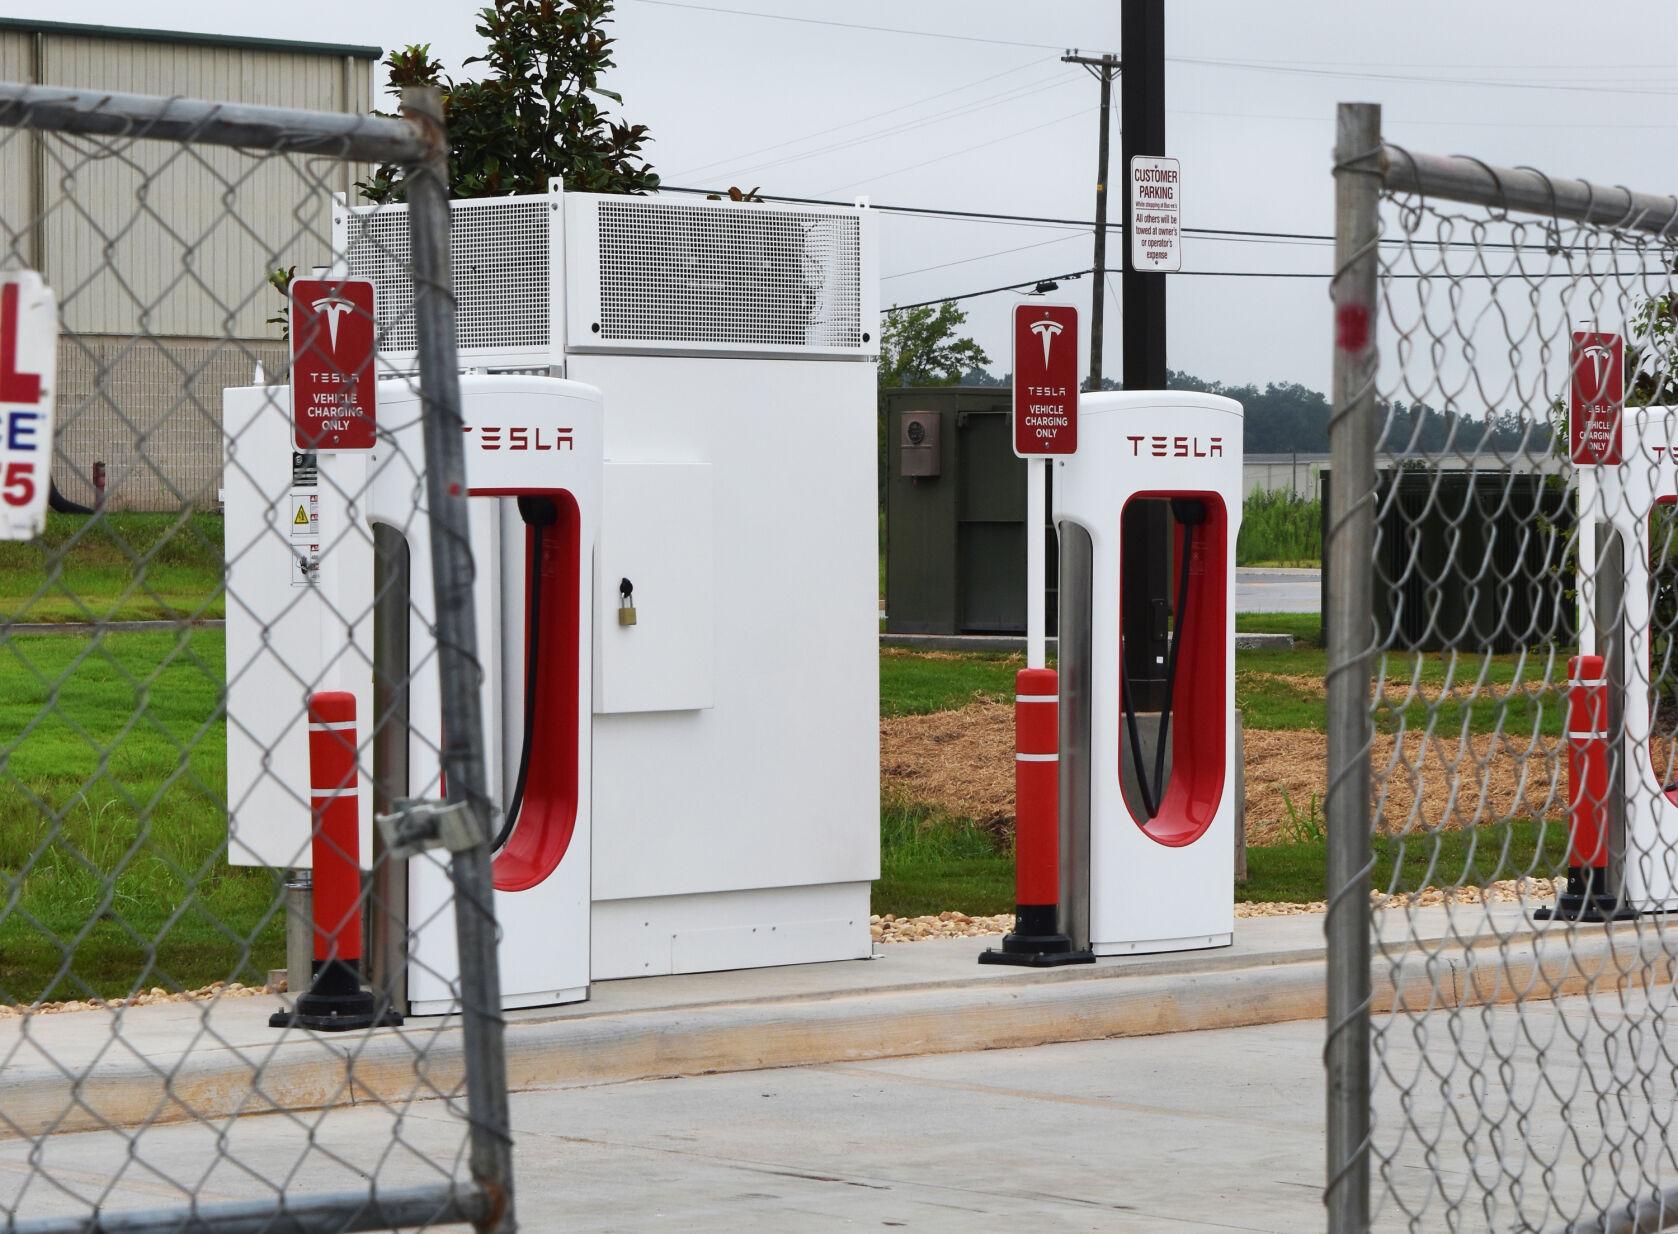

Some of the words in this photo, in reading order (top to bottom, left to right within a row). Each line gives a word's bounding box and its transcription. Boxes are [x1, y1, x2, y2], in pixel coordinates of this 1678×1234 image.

[1134, 168, 1178, 184] CUSTOMER
[1139, 185, 1174, 200] PARKING
[1135, 213, 1144, 223] All
[1143, 214, 1160, 224] others
[1160, 214, 1170, 224] will
[1170, 214, 1177, 225] be
[1135, 225, 1152, 235] towed
[1152, 226, 1158, 236] at
[1158, 226, 1178, 236] owner's
[1141, 239, 1147, 247] or
[1147, 238, 1173, 249] operator's
[1146, 250, 1168, 260] expense
[310, 372, 360, 383] TESLA
[1027, 386, 1066, 396] TESLA
[312, 392, 358, 404] VEHICLE
[307, 406, 364, 418] CHARGING
[1029, 404, 1064, 415] VEHICLE
[321, 419, 350, 431] ONLY
[1025, 416, 1068, 427] CHARGING
[1035, 428, 1058, 438] ONLY
[1126, 436, 1222, 458] TESLA
